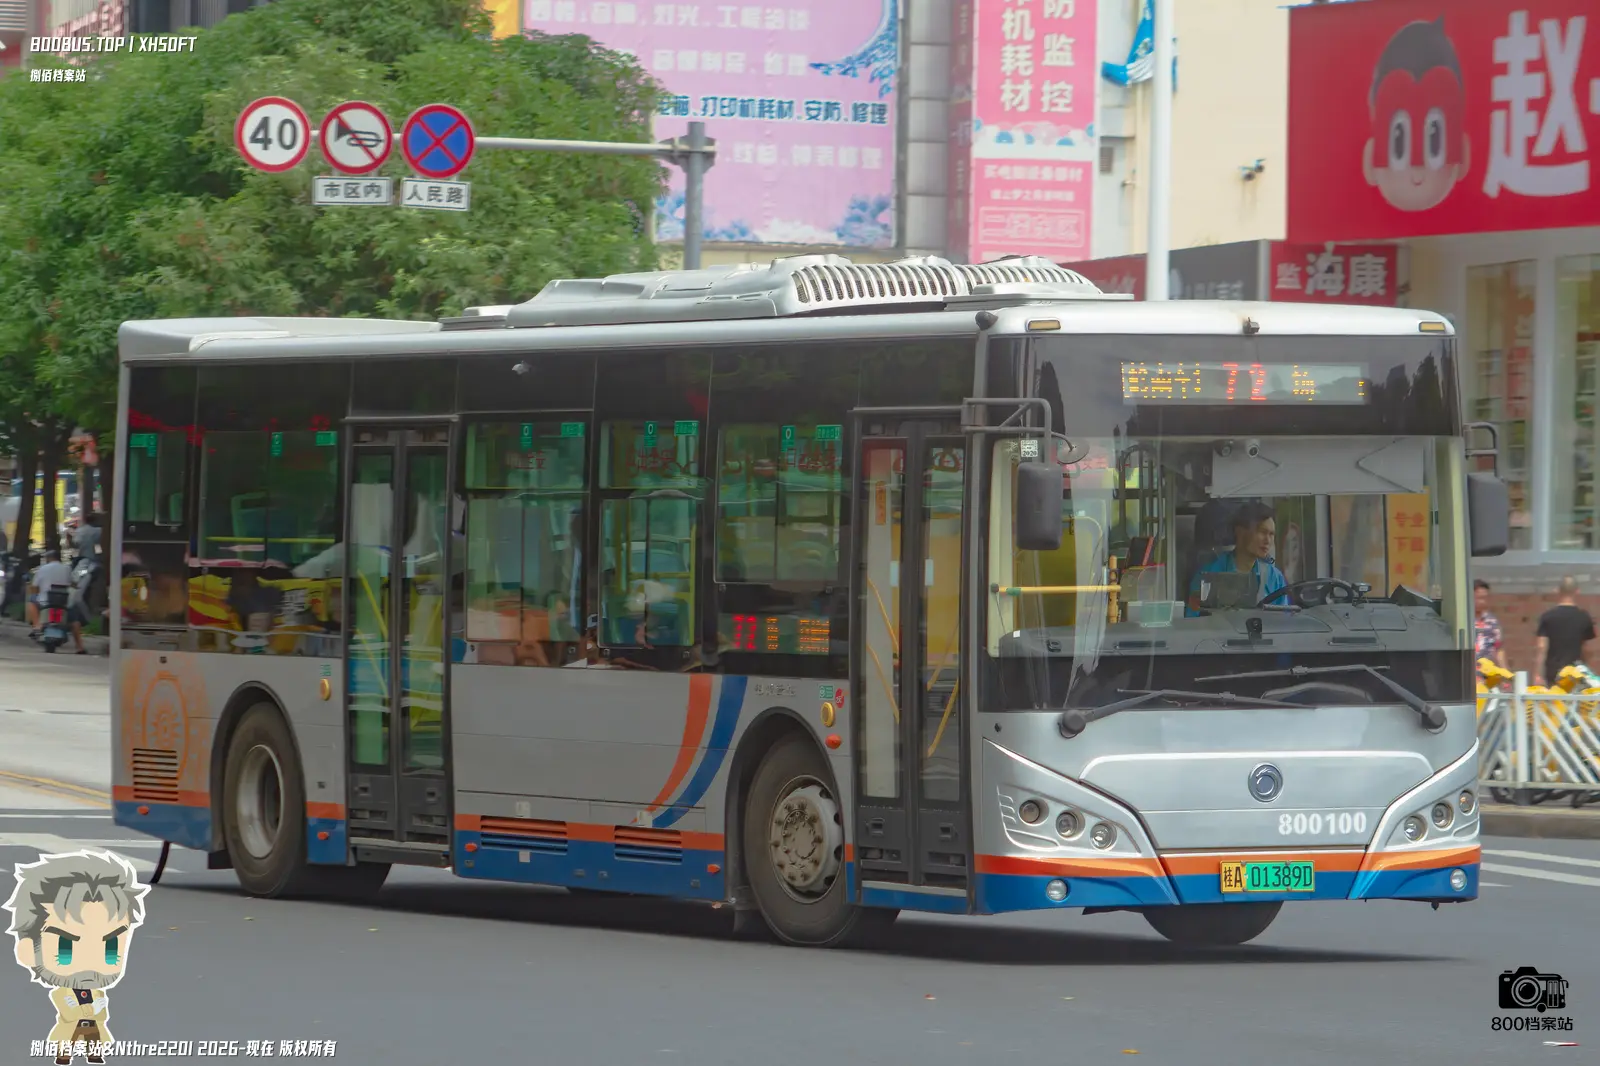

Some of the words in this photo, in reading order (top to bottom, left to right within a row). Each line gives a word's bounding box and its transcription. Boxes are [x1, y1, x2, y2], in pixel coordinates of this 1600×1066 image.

[1000, 0, 1035, 112] 机耗材
[1482, 9, 1600, 199] 赵
[249, 116, 298, 151] 40
[323, 182, 383, 200] 市区内
[406, 184, 463, 204] 人民路
[1222, 363, 1267, 401] 72
[1278, 812, 1367, 835] 800100
[1251, 865, 1313, 888] 01389D
